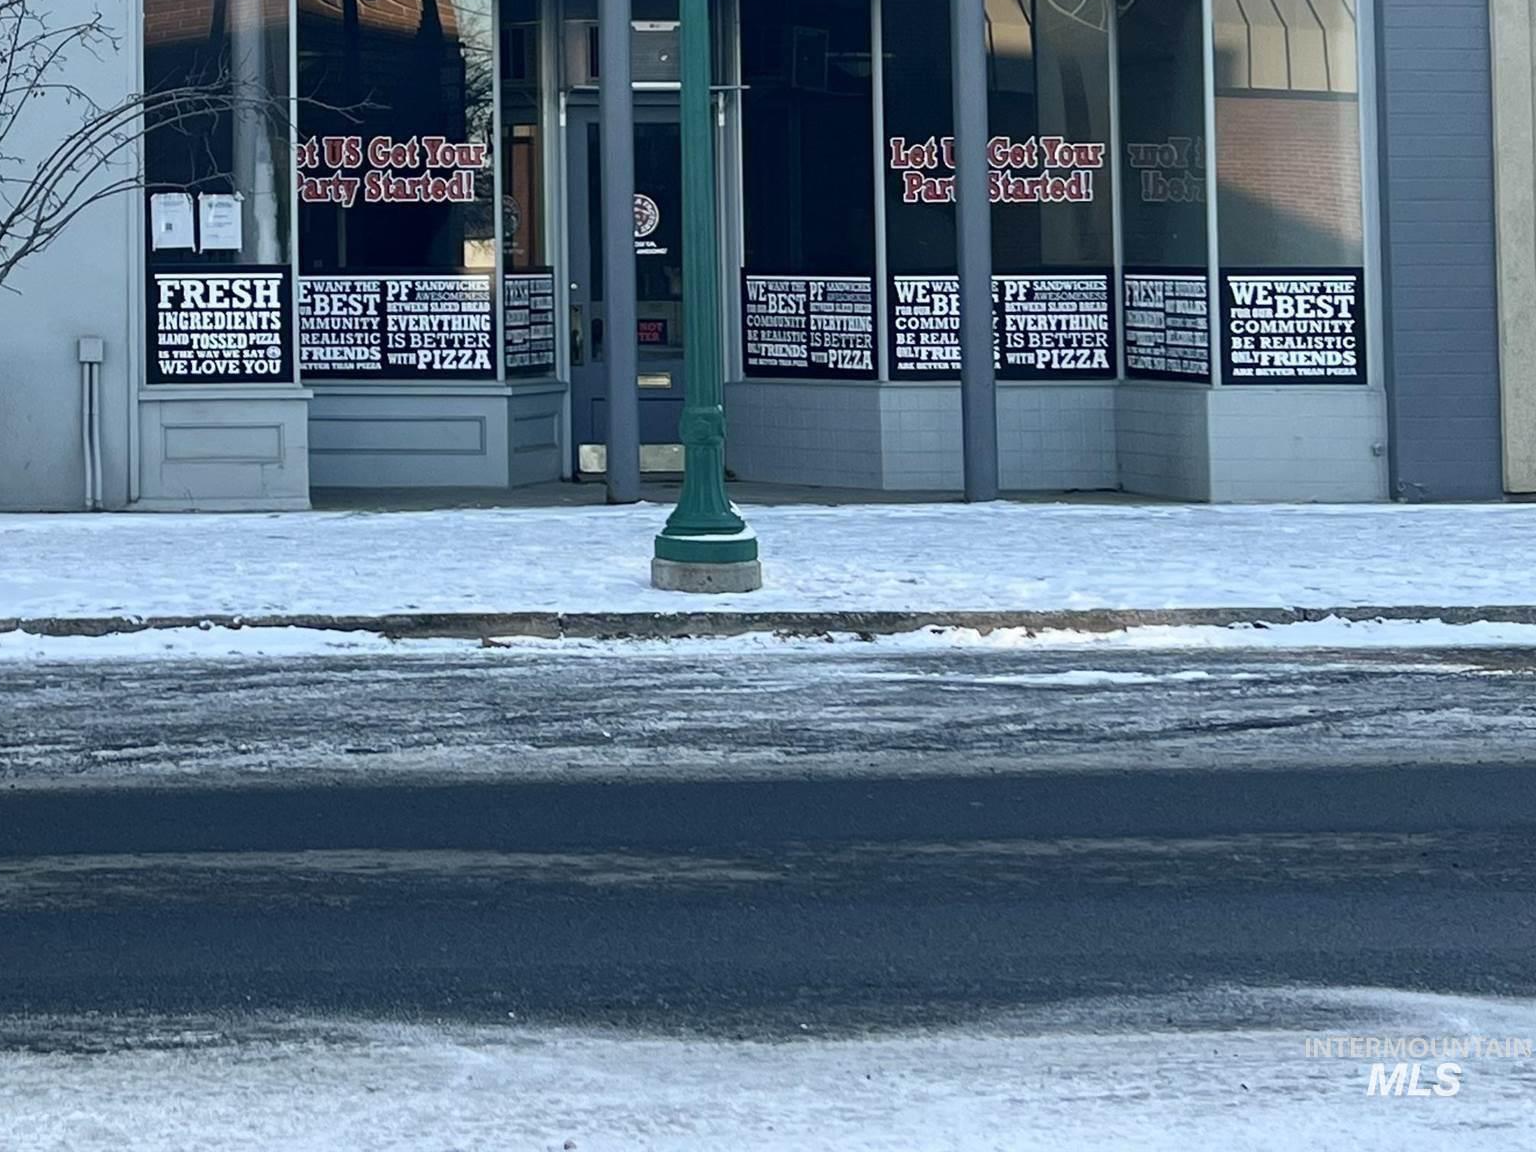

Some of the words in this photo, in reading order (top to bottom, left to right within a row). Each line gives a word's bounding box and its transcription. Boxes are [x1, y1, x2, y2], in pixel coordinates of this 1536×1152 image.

[297, 136, 319, 168] et
[322, 136, 363, 168] US
[368, 135, 420, 168] Get
[422, 136, 486, 168] Your
[890, 136, 938, 169] Let
[987, 136, 1038, 169] Get
[1040, 136, 1105, 168] Your
[365, 169, 474, 202] Started!
[903, 170, 956, 202] Par
[988, 169, 1093, 202] Started!
[157, 279, 280, 308] FRESH
[313, 281, 352, 292] WANT
[354, 281, 380, 292] THE
[386, 280, 412, 301] PF
[415, 281, 490, 291] SANDWICHES
[746, 281, 767, 301] WE
[809, 281, 825, 301] PF
[894, 281, 930, 303] WE
[931, 281, 960, 292] WAN
[1004, 281, 1030, 301] PF
[1033, 281, 1107, 291] SANDWICHES
[1124, 280, 1164, 308] FRESH
[1229, 282, 1273, 305] WE
[1274, 282, 1321, 293] WANT
[1323, 282, 1355, 293] THE
[313, 294, 380, 315] BEST
[415, 292, 490, 301] AWESOMENESS
[767, 293, 806, 314] BEST
[1033, 292, 1107, 301] AWESOMENESS
[1274, 295, 1355, 318] BEST
[158, 311, 281, 330] INGREDIENTS
[301, 317, 380, 330] MMUNITY
[387, 315, 491, 331] EVERYTHING
[810, 315, 872, 332] EVERYTHING
[1005, 314, 1108, 331] EVERYTHING
[1230, 320, 1355, 334] COMMUNITY
[158, 333, 189, 345] HAND
[190, 333, 247, 349] TOSSED
[249, 333, 281, 344] PIZZA
[301, 333, 381, 344] REALISTIC
[387, 333, 405, 348] IS
[410, 333, 491, 348] BETTER
[761, 330, 807, 342] REALISTIC
[810, 332, 822, 347] IS
[824, 332, 872, 348] BETTER
[896, 333, 915, 344] BE
[1006, 333, 1024, 348] IS
[1028, 333, 1108, 347] BETTER
[1231, 337, 1255, 349] BE
[1259, 337, 1356, 349] REALISTIC
[158, 350, 169, 358] IS
[172, 350, 194, 358] THE
[197, 350, 220, 358] WAY
[222, 350, 240, 358] WE
[243, 350, 265, 358] SAY
[301, 346, 381, 360] FRIENDS
[387, 353, 417, 364] WITH
[417, 349, 491, 369] PIZZA
[761, 343, 808, 358] FRIENDS
[1006, 353, 1035, 364] WITH
[1035, 349, 1110, 369] PIZZA
[1260, 351, 1356, 366] FRIENDS
[159, 360, 187, 374] WE
[191, 360, 240, 374] LOVE
[243, 360, 281, 374] YOU
[828, 349, 873, 370] PIZZA
